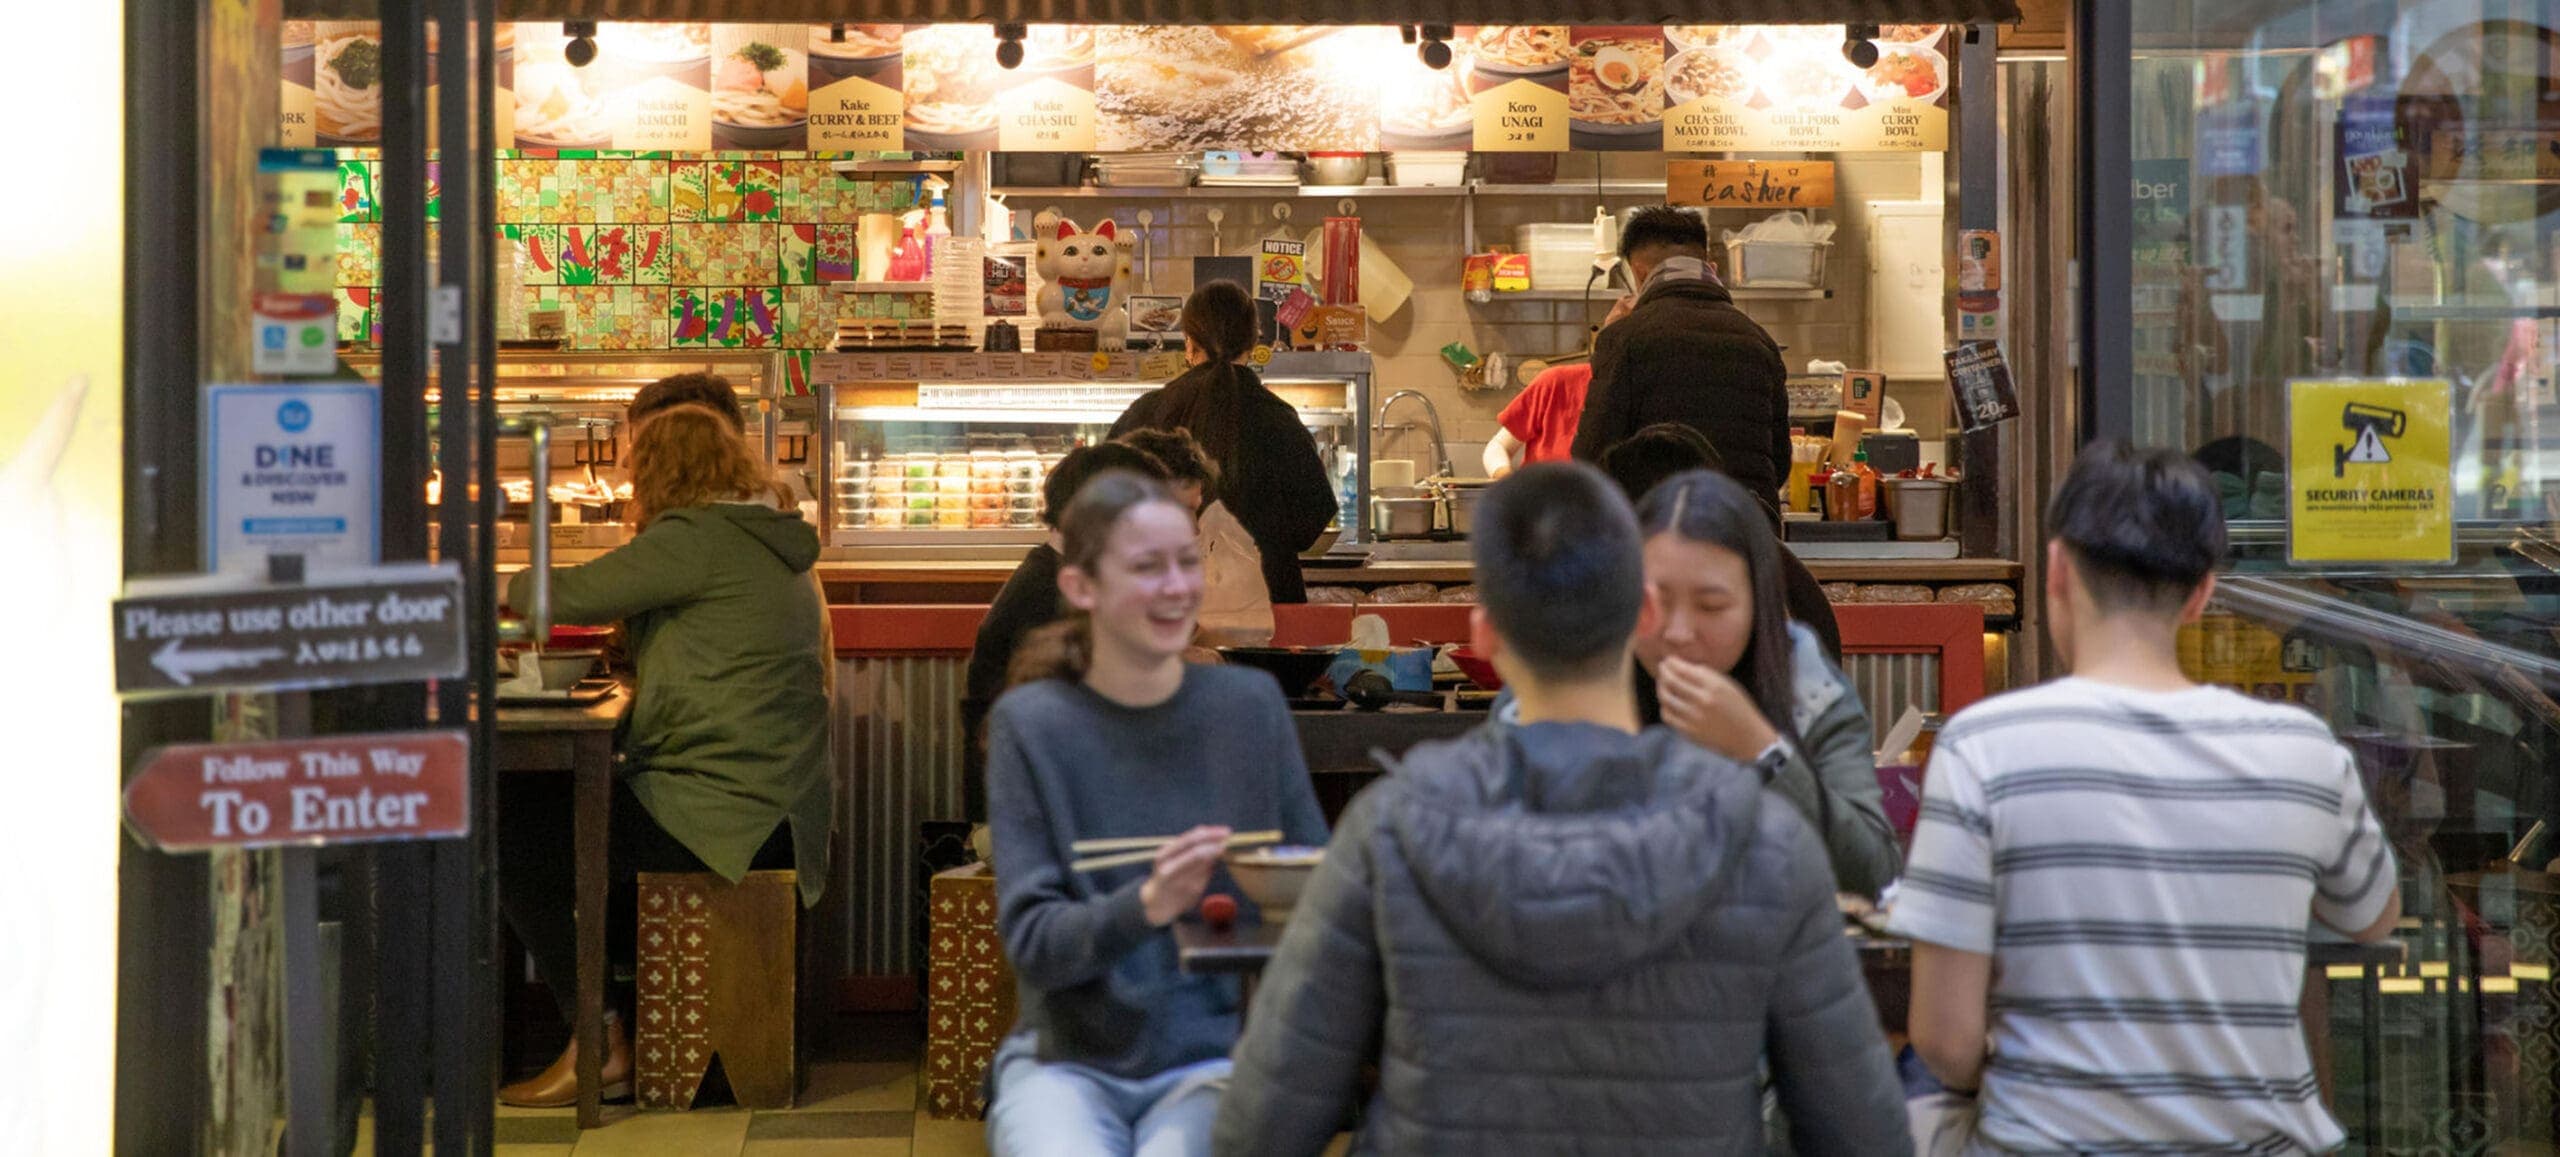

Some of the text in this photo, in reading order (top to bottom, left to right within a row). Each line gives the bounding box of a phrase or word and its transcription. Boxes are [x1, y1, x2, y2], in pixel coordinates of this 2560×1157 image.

[840, 99, 870, 111] Kake
[1508, 101, 1537, 113] Koro
[809, 114, 900, 126] CURRY & BEEF
[1501, 116, 1543, 128] UNAGI
[1807, 114, 1840, 125] PORK
[1881, 114, 1922, 125] CURRY
[1674, 126, 1748, 136] MAYO BOWL
[1789, 126, 1822, 136] BOWL
[1885, 126, 1918, 136] BOWL
[1702, 169, 1801, 203] cashier
[1265, 241, 1303, 255] NOTICE
[1325, 315, 1355, 326] Sauce
[2306, 489, 2434, 502] SECURITY CAMERAS
[124, 591, 449, 640] Please use other door
[202, 748, 426, 785] Follow This Way
[200, 786, 429, 837] To Enter
